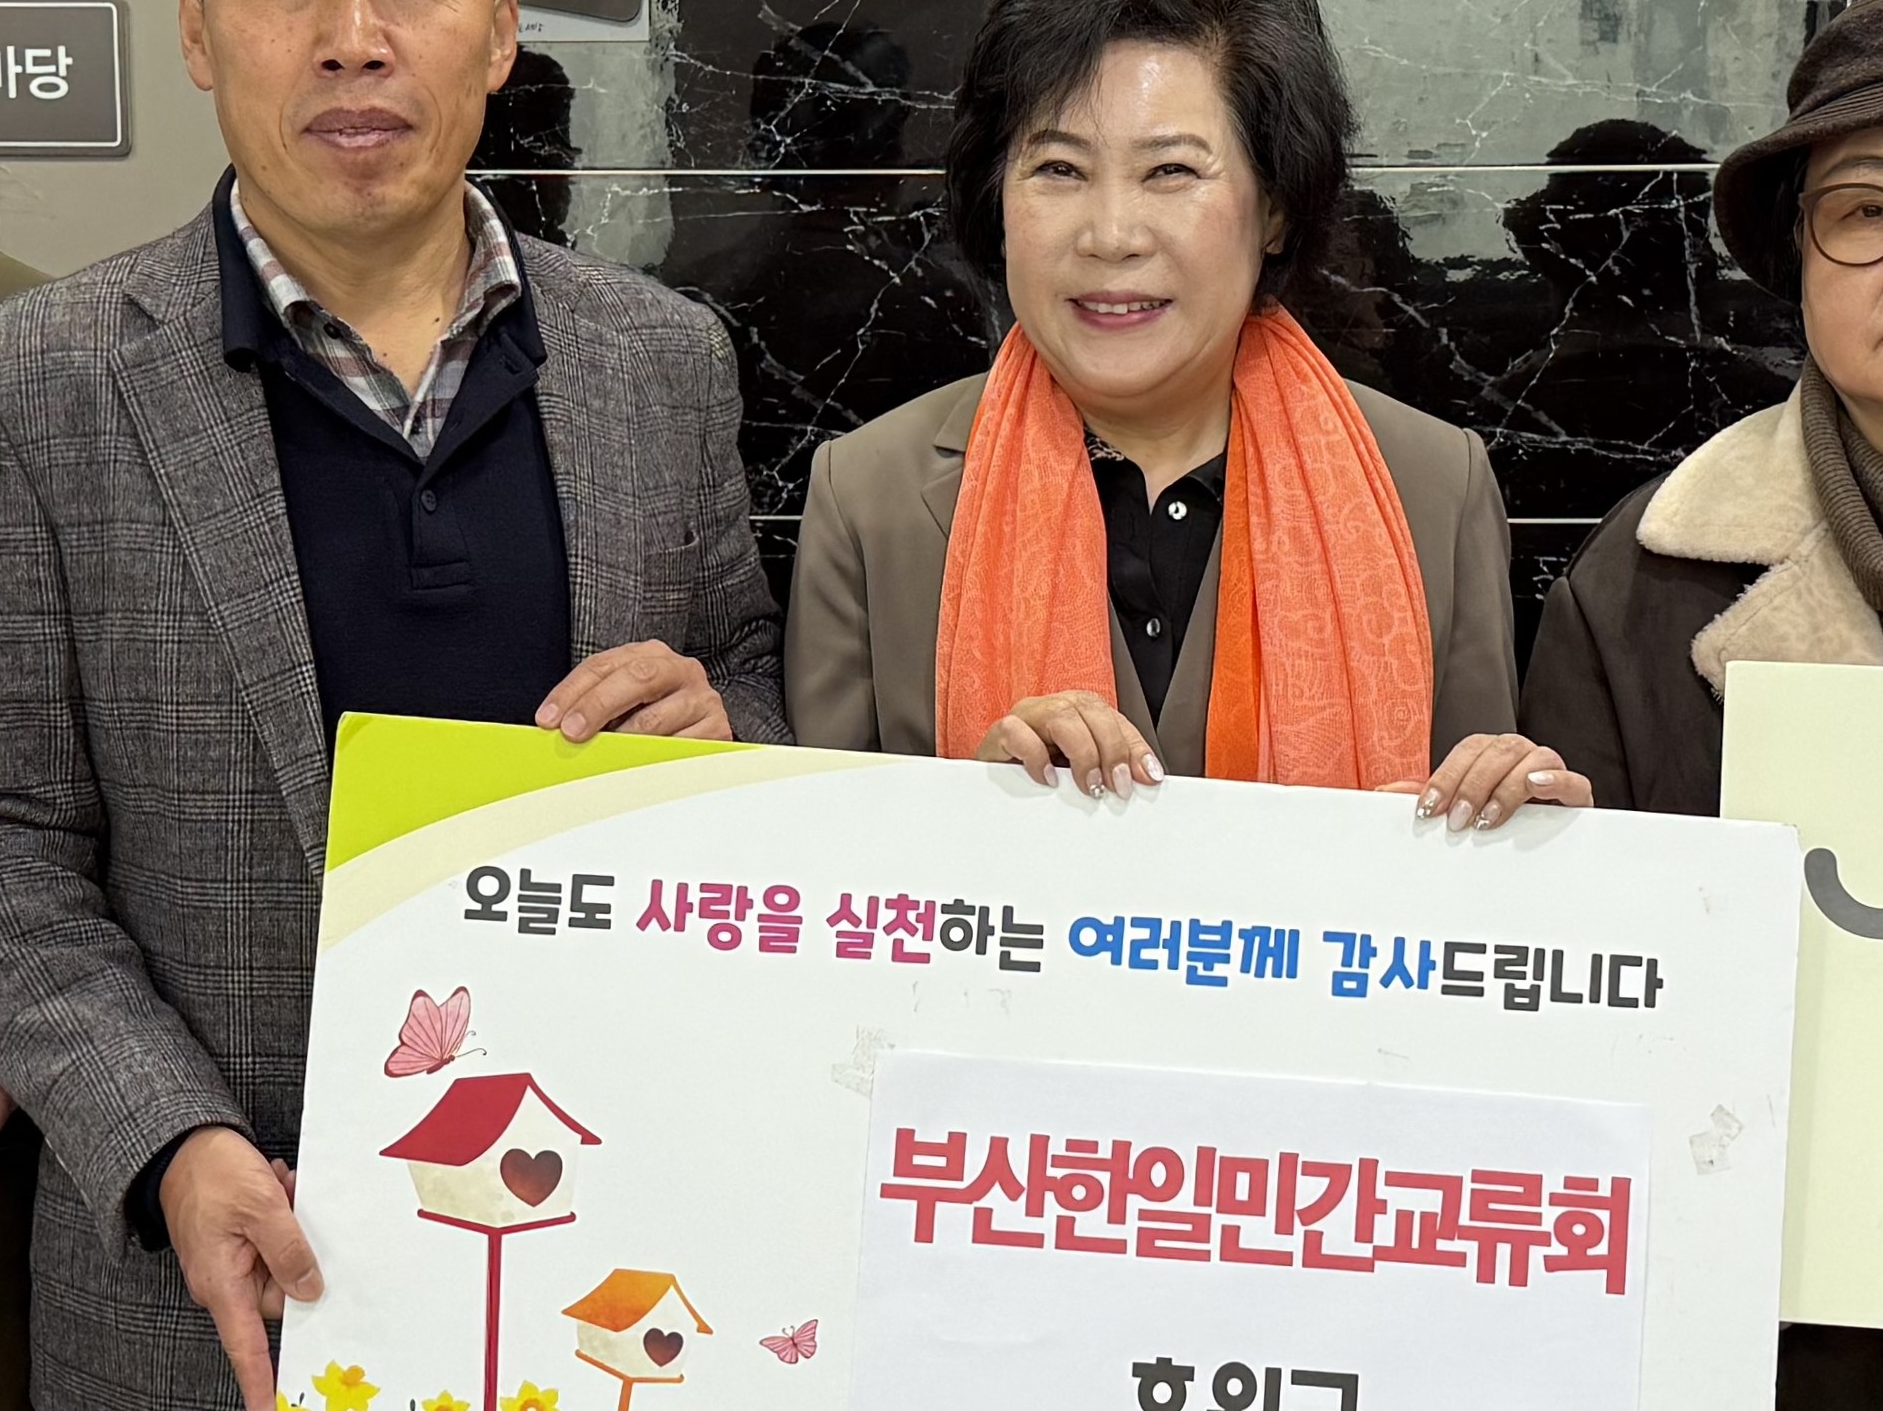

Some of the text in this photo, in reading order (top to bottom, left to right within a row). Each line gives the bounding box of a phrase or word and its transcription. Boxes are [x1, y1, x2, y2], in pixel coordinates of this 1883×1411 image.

[461, 863, 1665, 1015] 오늘도 사랑을 실천하는 여러분께 감사드립니다
[878, 1123, 1635, 1298] 부산한일민간교류회
